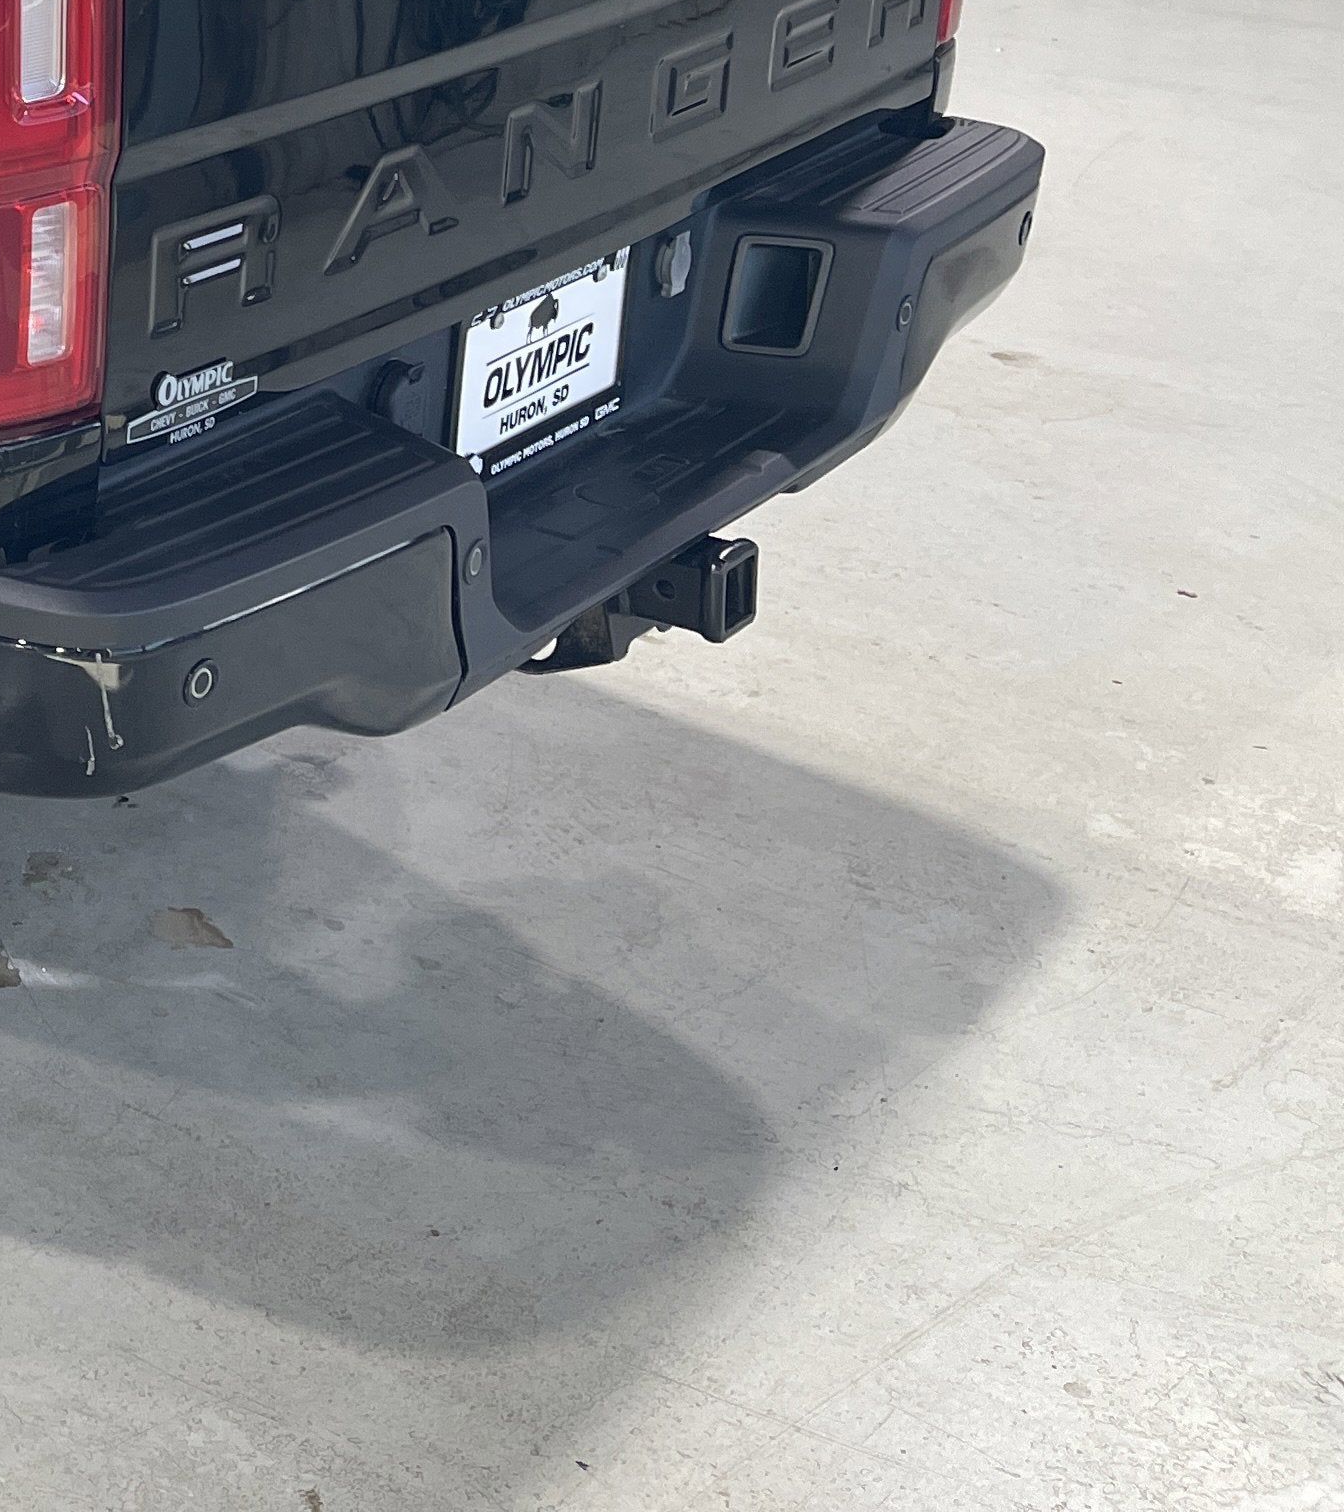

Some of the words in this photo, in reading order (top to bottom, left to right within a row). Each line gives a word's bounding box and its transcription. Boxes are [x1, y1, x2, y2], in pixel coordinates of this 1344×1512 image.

[501, 257, 606, 311] OLYMPICMOTORS.COM
[157, 360, 234, 407] OLYMPIC
[483, 322, 594, 409] OLYMPIC
[150, 411, 177, 432] CHEVY
[185, 399, 210, 418] BUICK
[218, 388, 237, 405] GMC
[204, 416, 216, 431] SD
[499, 395, 548, 436] HURON,
[552, 384, 570, 407] SD
[490, 451, 522, 476] OLYMPIC
[522, 435, 555, 460] MOTORS,
[554, 421, 579, 443] HURON
[579, 416, 590, 430] SD
[594, 397, 621, 422] GMC
